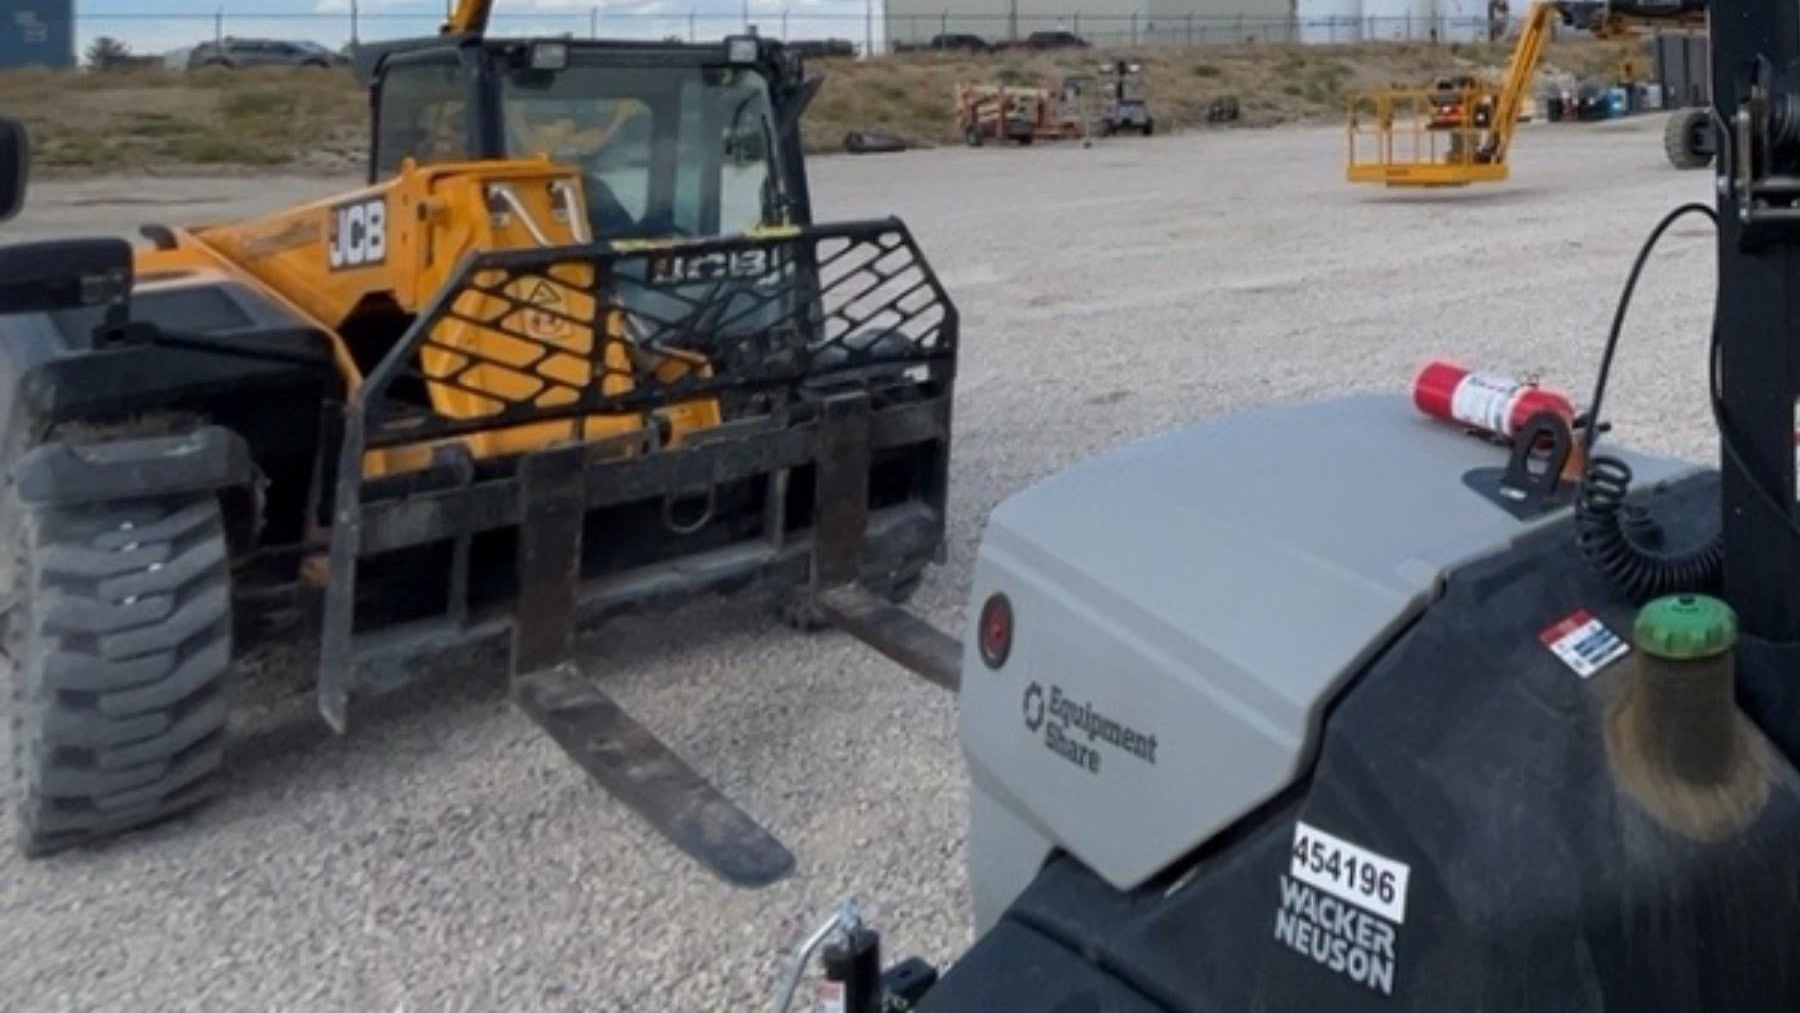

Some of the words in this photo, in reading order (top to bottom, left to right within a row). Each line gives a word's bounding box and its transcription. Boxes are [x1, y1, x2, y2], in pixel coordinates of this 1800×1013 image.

[329, 199, 386, 268] JCB
[653, 248, 767, 285] JCB
[1045, 720, 1100, 774] Share
[1049, 684, 1158, 765] Equipment
[1292, 835, 1396, 904] 454196
[1279, 874, 1396, 959] WACKER
[1274, 907, 1395, 996] NEUSON
